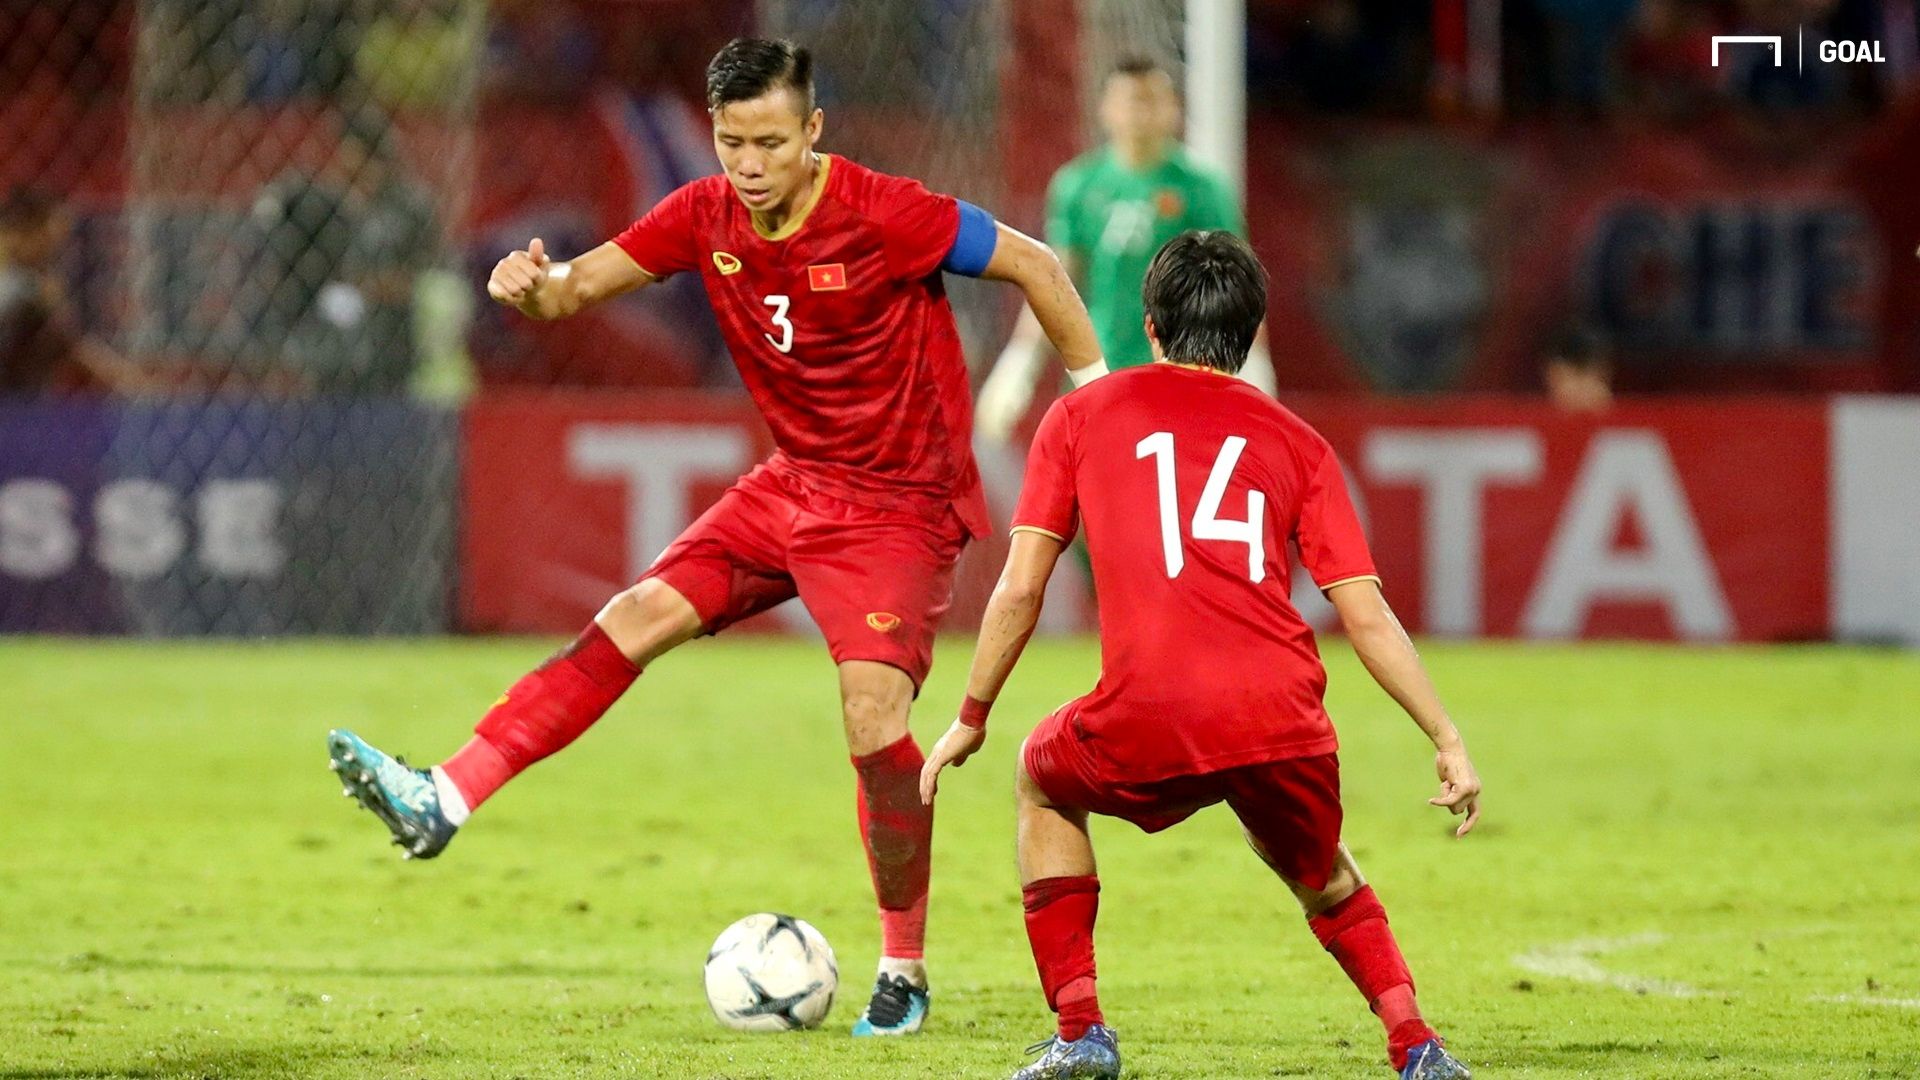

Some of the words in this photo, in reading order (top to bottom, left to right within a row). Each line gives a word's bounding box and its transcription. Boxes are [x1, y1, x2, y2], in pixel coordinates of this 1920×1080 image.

[764, 295, 793, 353] 3
[568, 426, 1737, 640] TTA
[1135, 432, 1267, 584] 14
